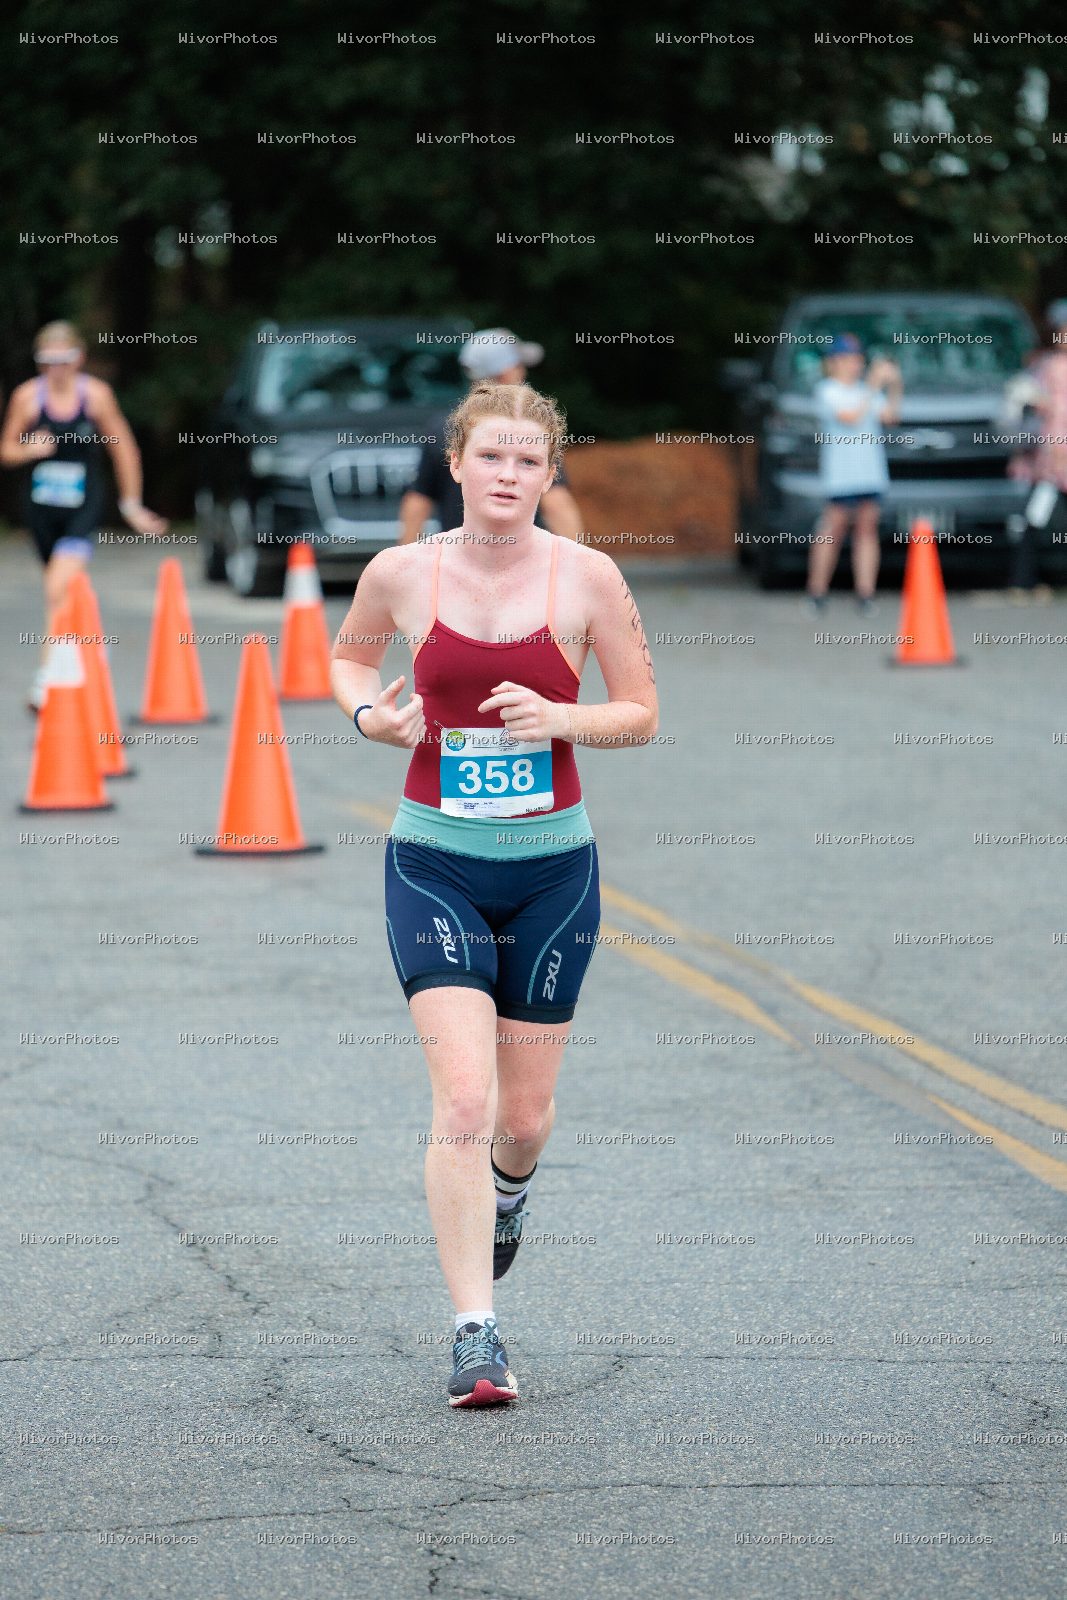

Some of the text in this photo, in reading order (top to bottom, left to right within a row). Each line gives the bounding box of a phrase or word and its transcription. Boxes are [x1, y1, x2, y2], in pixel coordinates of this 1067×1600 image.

[458, 758, 535, 795] 358
[433, 917, 459, 964] 2XU
[542, 949, 562, 1001] 2XU
